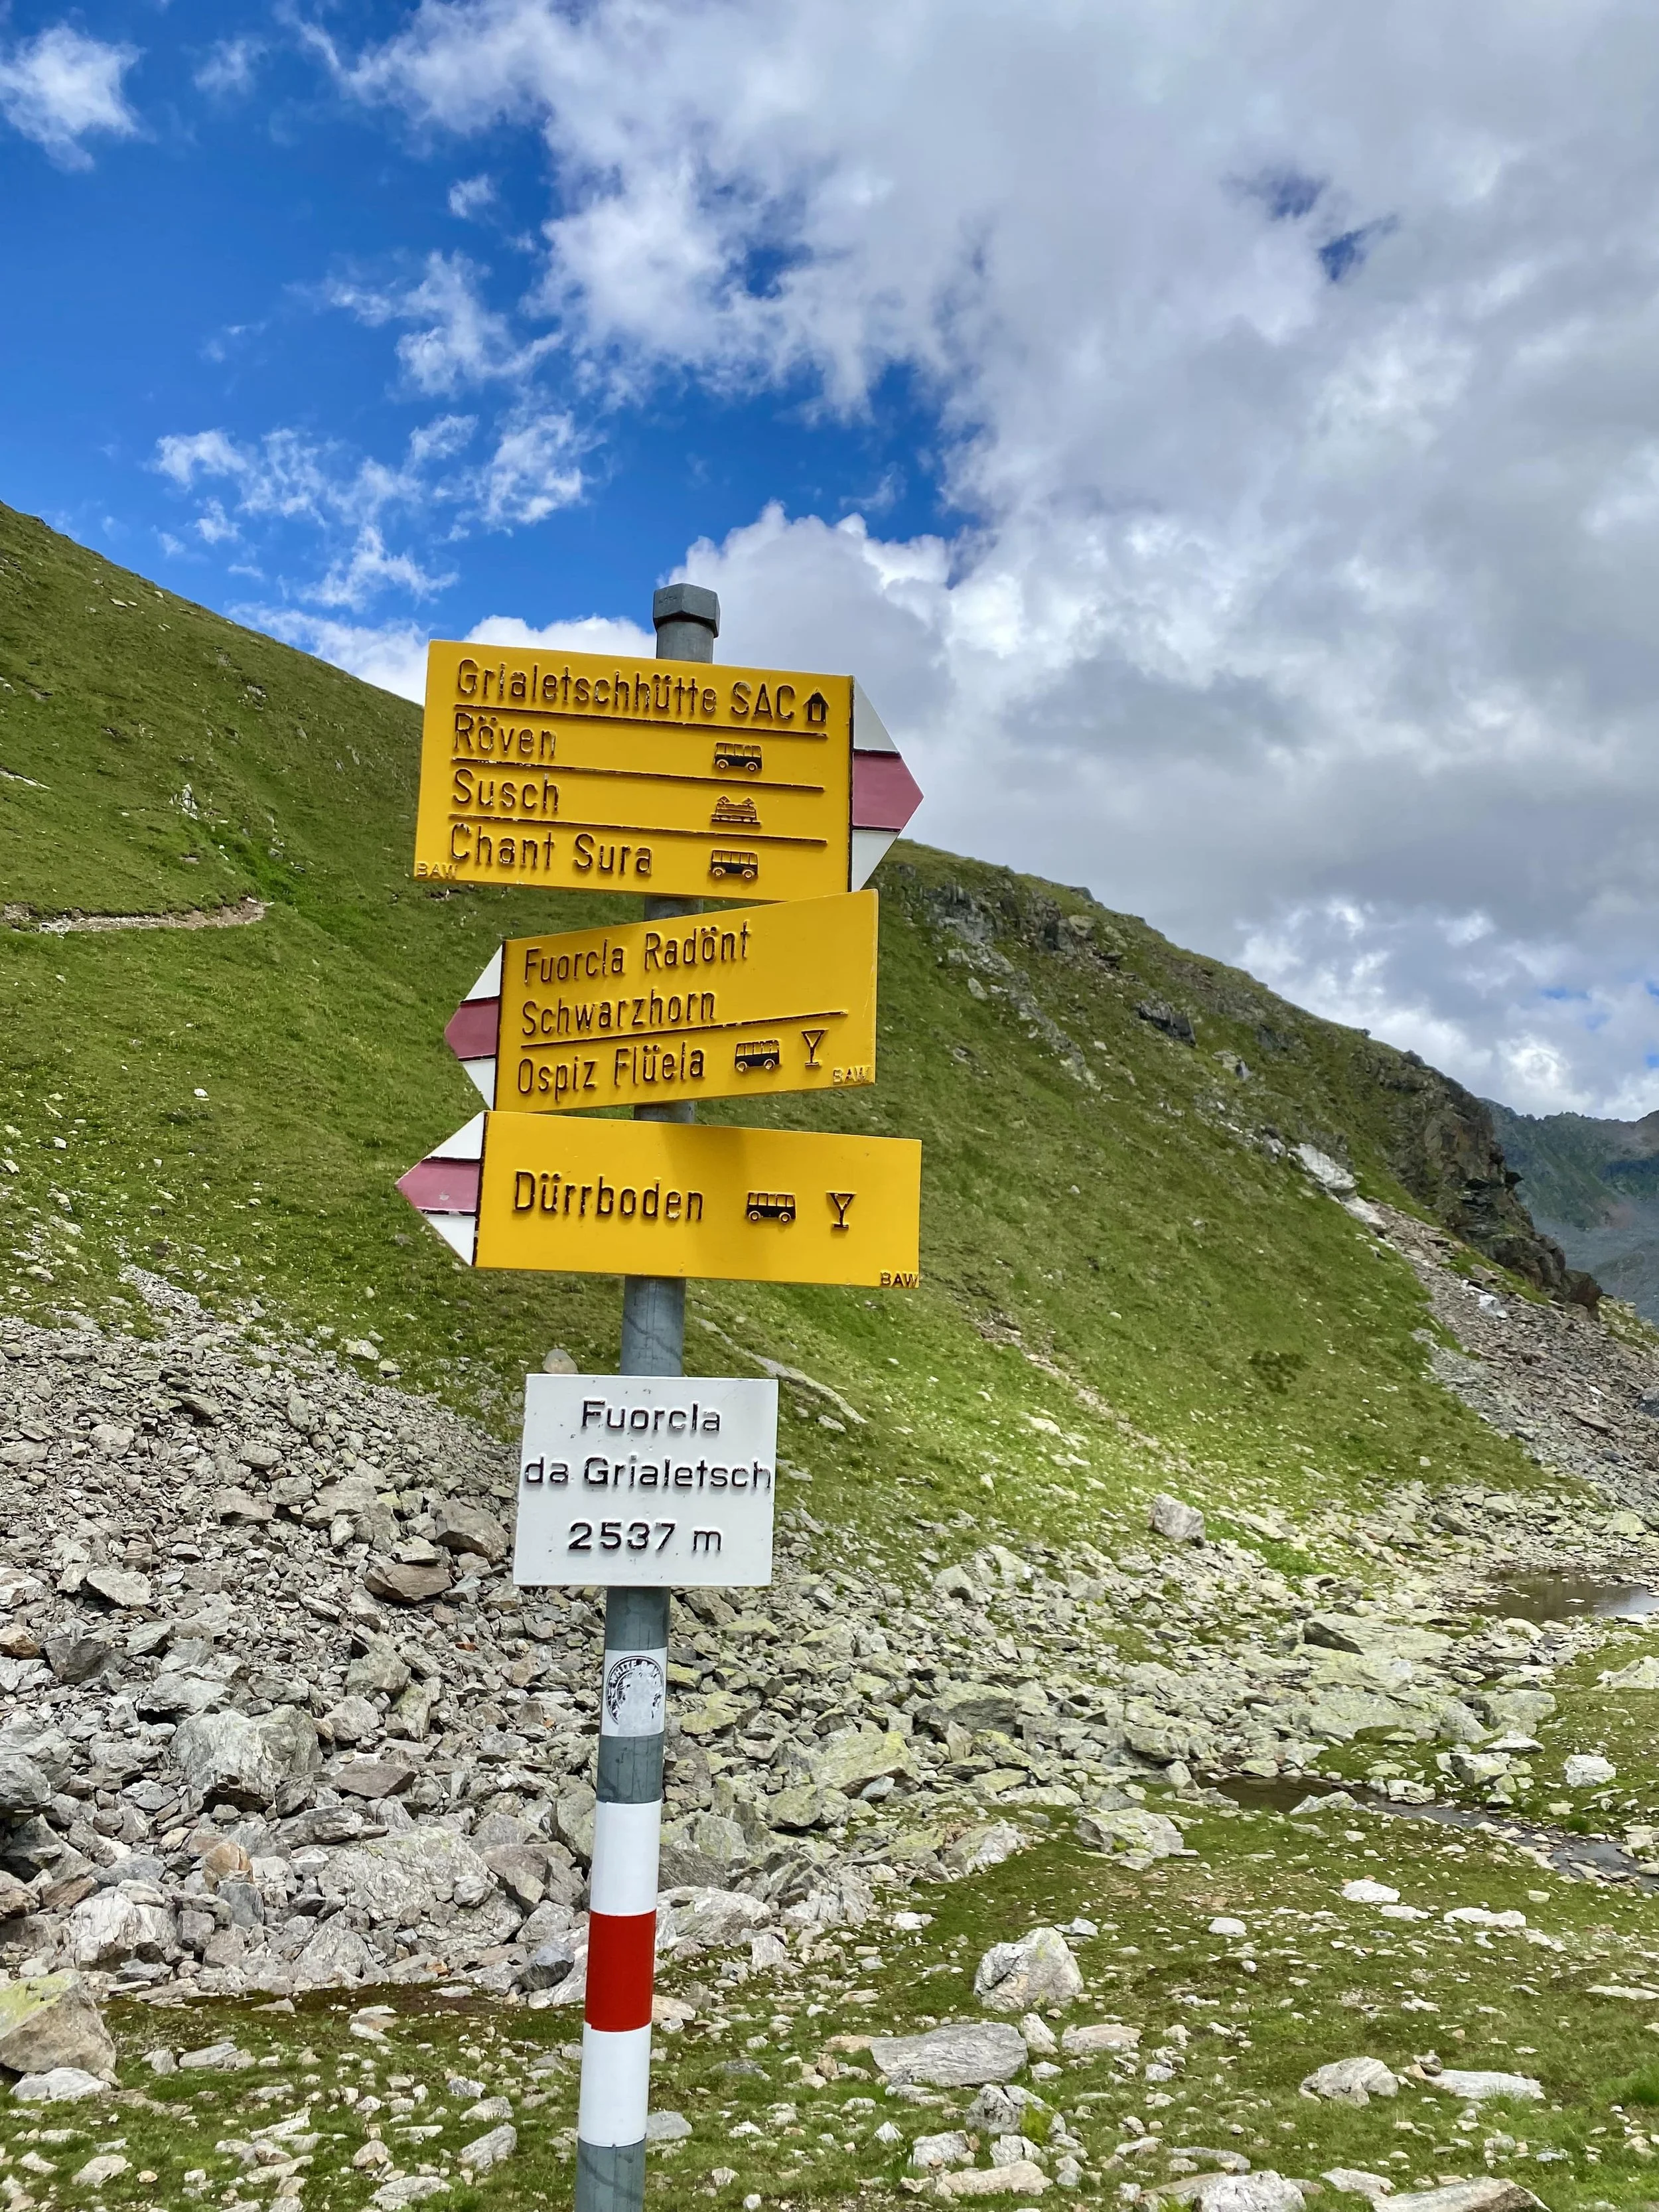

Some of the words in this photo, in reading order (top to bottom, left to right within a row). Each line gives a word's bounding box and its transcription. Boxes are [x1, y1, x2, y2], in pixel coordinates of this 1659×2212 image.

[457, 659, 717, 713] Grialetschhütte
[731, 681, 795, 719] SAC
[454, 712, 557, 757] Röven
[452, 768, 559, 812] Susch
[451, 823, 554, 869] Chant
[573, 833, 652, 875] Sura
[524, 938, 626, 984] Fuorcla
[644, 920, 751, 970] Radönt
[522, 988, 717, 1036] Schwarzhorn
[518, 1056, 598, 1101] Ospiz
[614, 1041, 705, 1086] Flüela
[513, 1169, 705, 1222] Dürrboden
[880, 1272, 918, 1288] BAW
[581, 1400, 721, 1432] Fuorcla
[524, 1456, 569, 1485] da
[583, 1455, 771, 1489] Grialetsch
[568, 1521, 677, 1552] 2537
[693, 1528, 722, 1552] m
